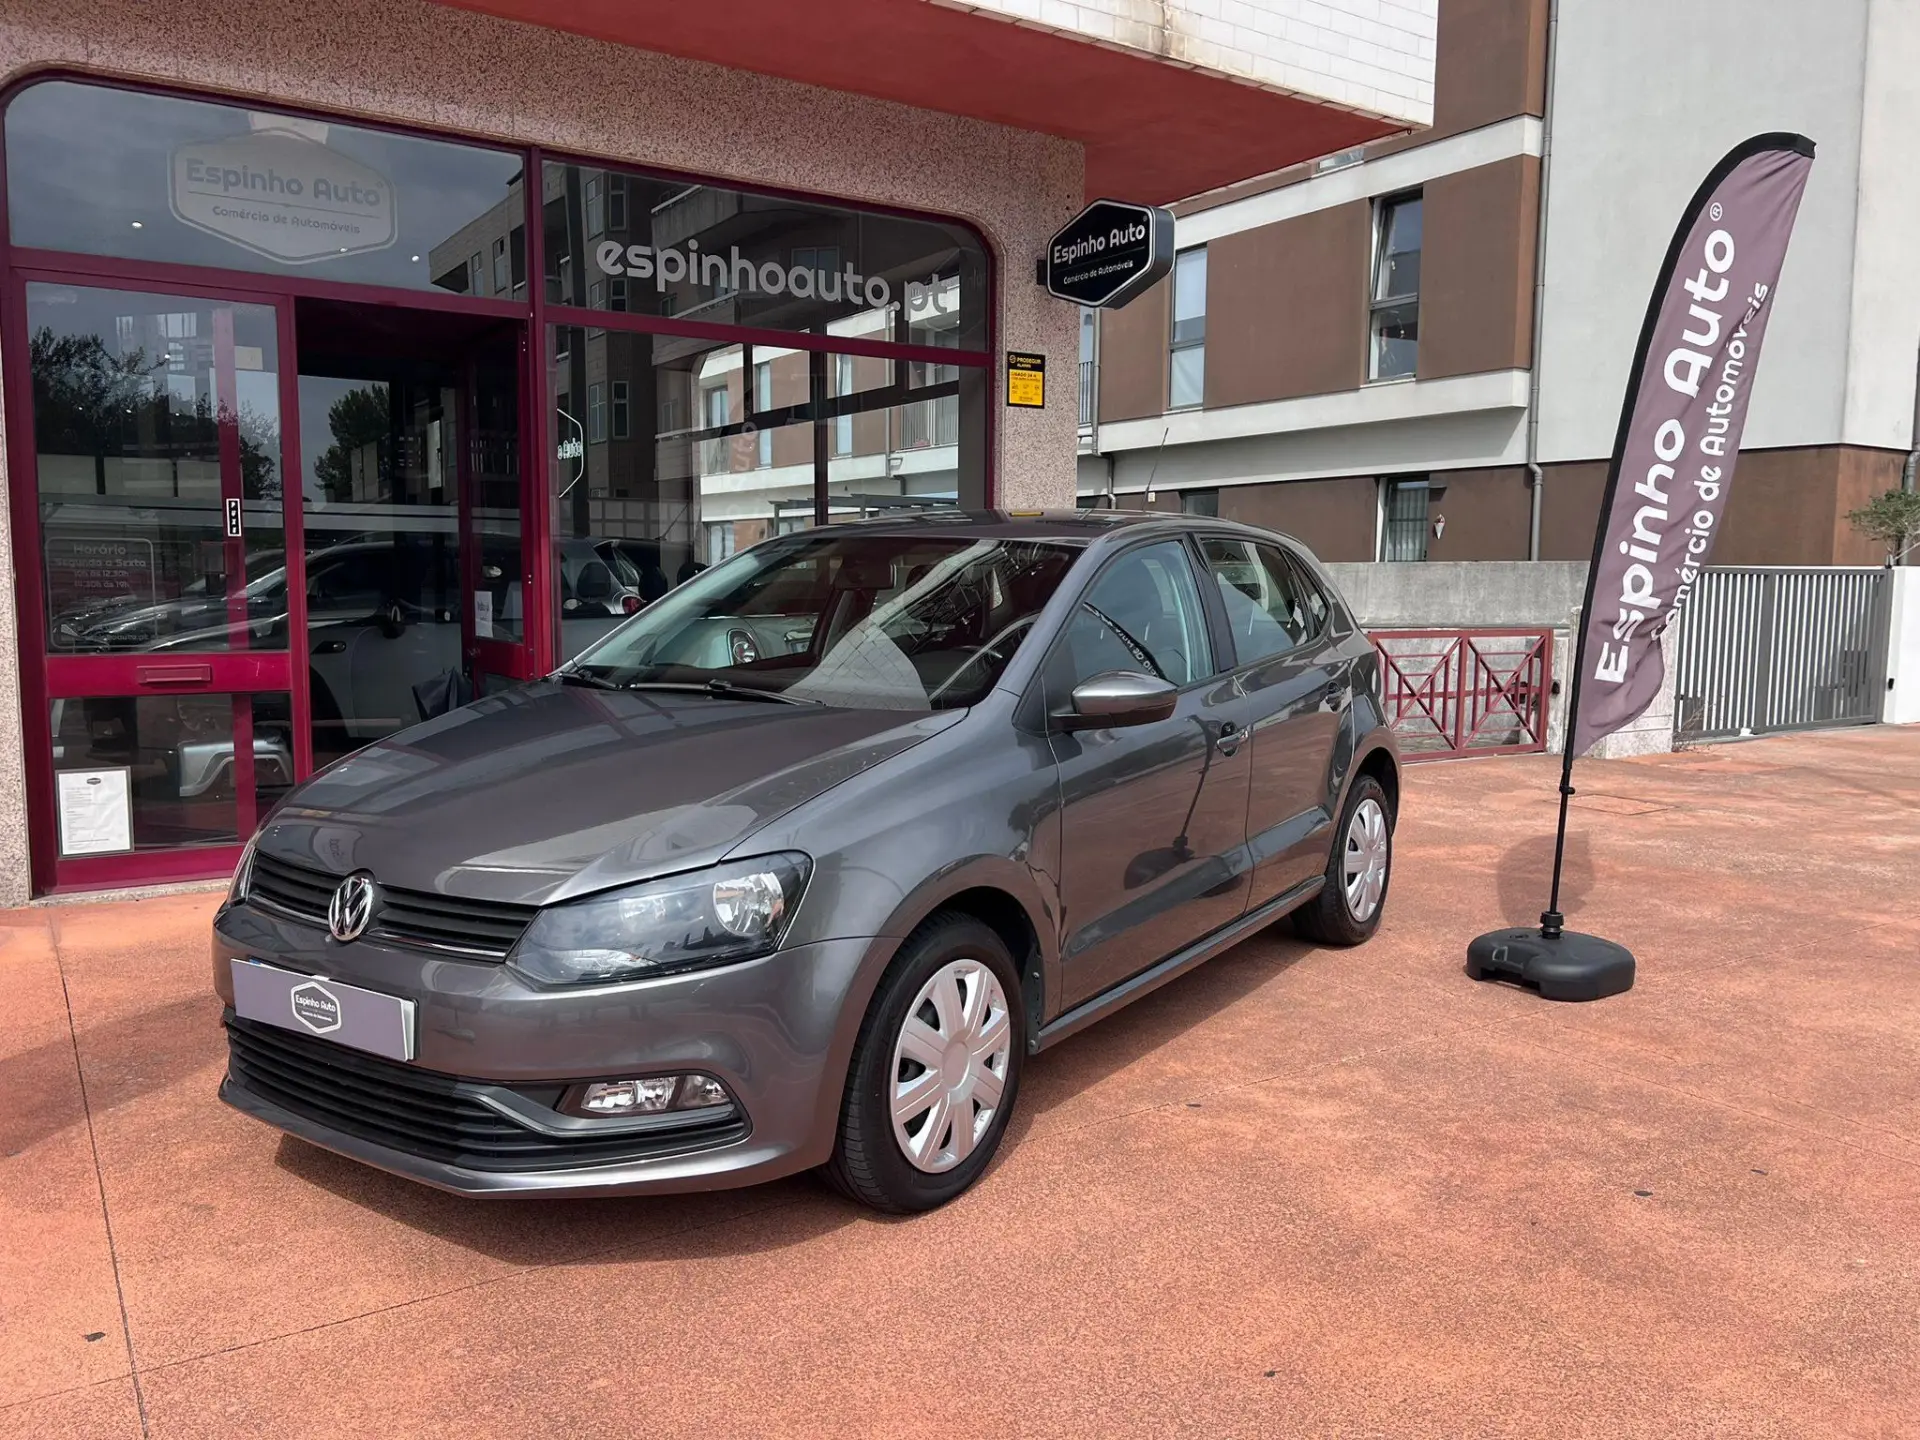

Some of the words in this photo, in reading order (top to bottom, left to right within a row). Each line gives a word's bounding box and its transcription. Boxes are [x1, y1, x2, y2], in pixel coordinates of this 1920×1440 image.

[186, 158, 304, 195] Espinho
[313, 178, 381, 207] Auto
[212, 205, 269, 222] Comércio
[273, 212, 288, 225] de
[291, 216, 361, 235] Automóveis
[1053, 235, 1106, 264] Espinho
[1109, 223, 1146, 248] Auto
[596, 239, 951, 321] espinhoauto.pt
[1089, 269, 1097, 278] de
[1594, 418, 1685, 683] Espinho
[1663, 229, 1735, 399] Auto
[1693, 465, 1722, 501] de
[73, 543, 127, 555] Horário
[295, 994, 320, 1009] Espinho
[320, 1000, 336, 1012] Auto
